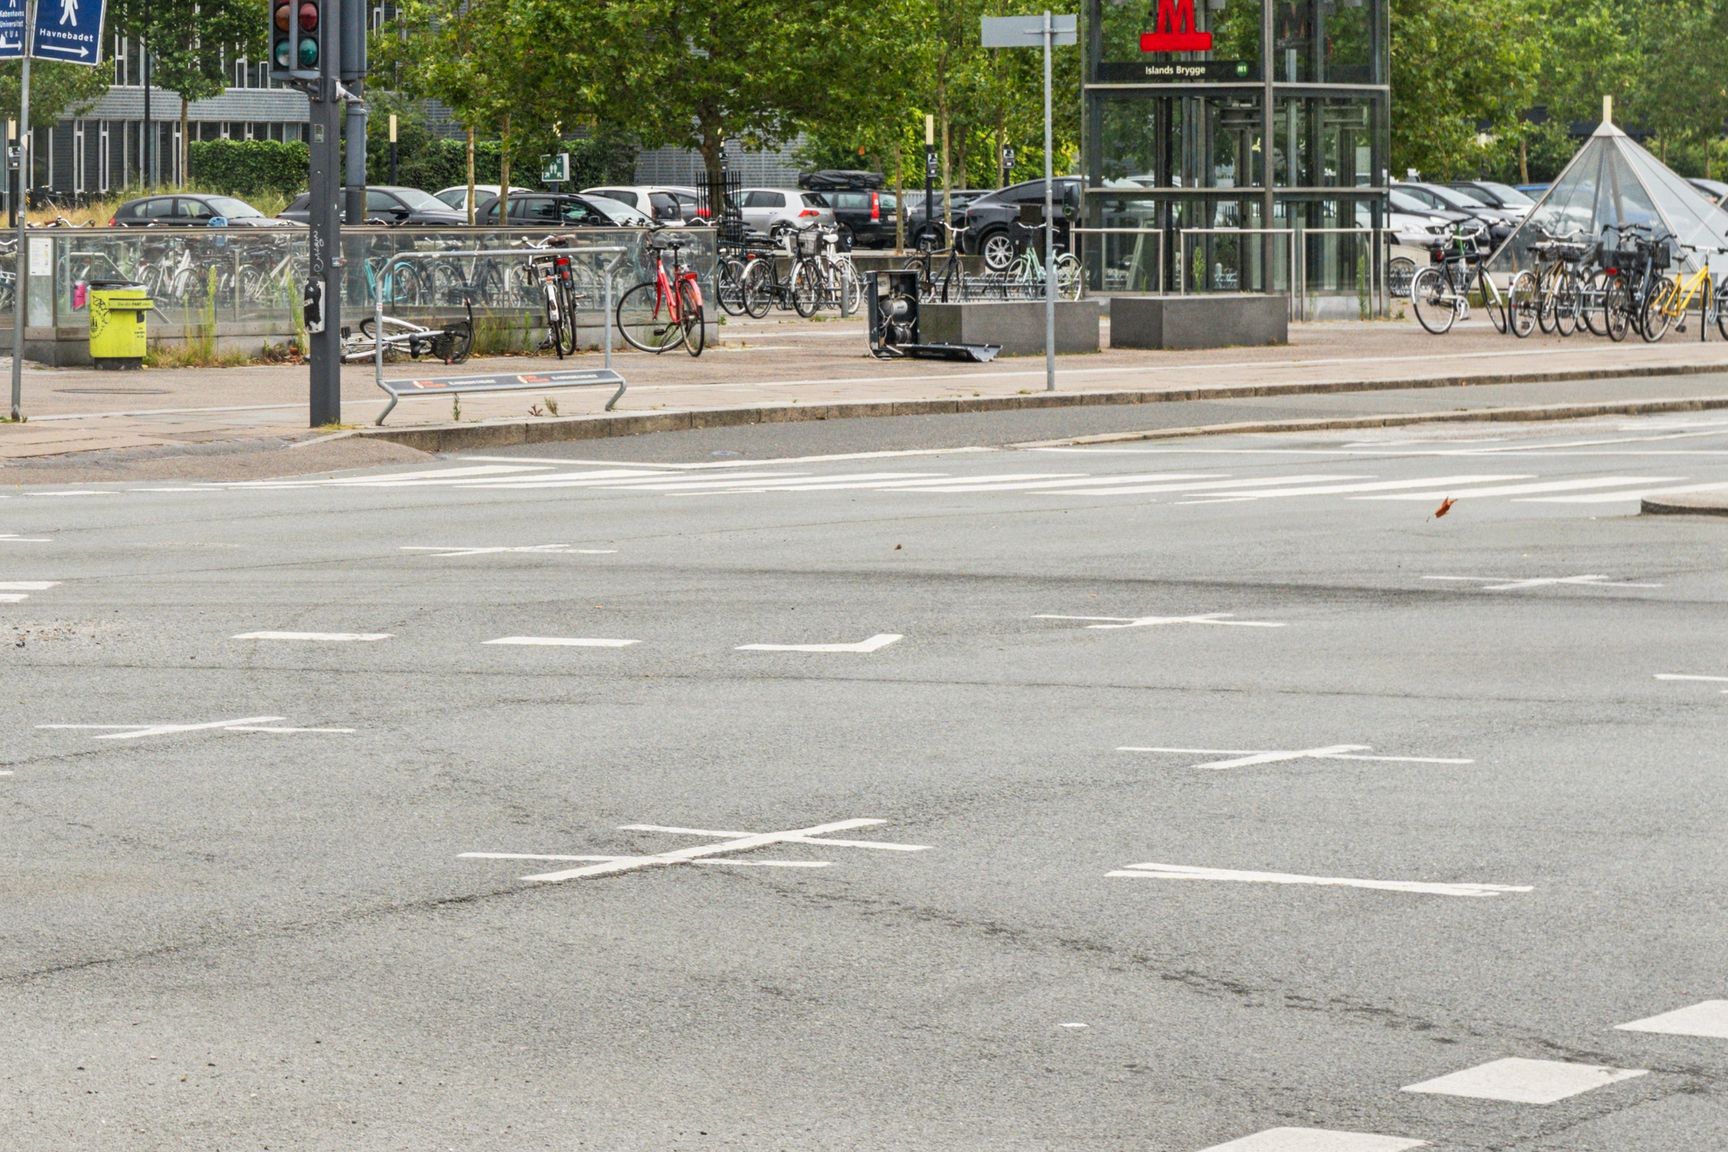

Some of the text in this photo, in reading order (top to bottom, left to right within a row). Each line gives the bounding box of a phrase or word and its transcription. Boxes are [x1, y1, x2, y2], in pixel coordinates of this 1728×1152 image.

[39, 28, 94, 43] Havnebadet
[1145, 65, 1206, 76] Islands Brygge
